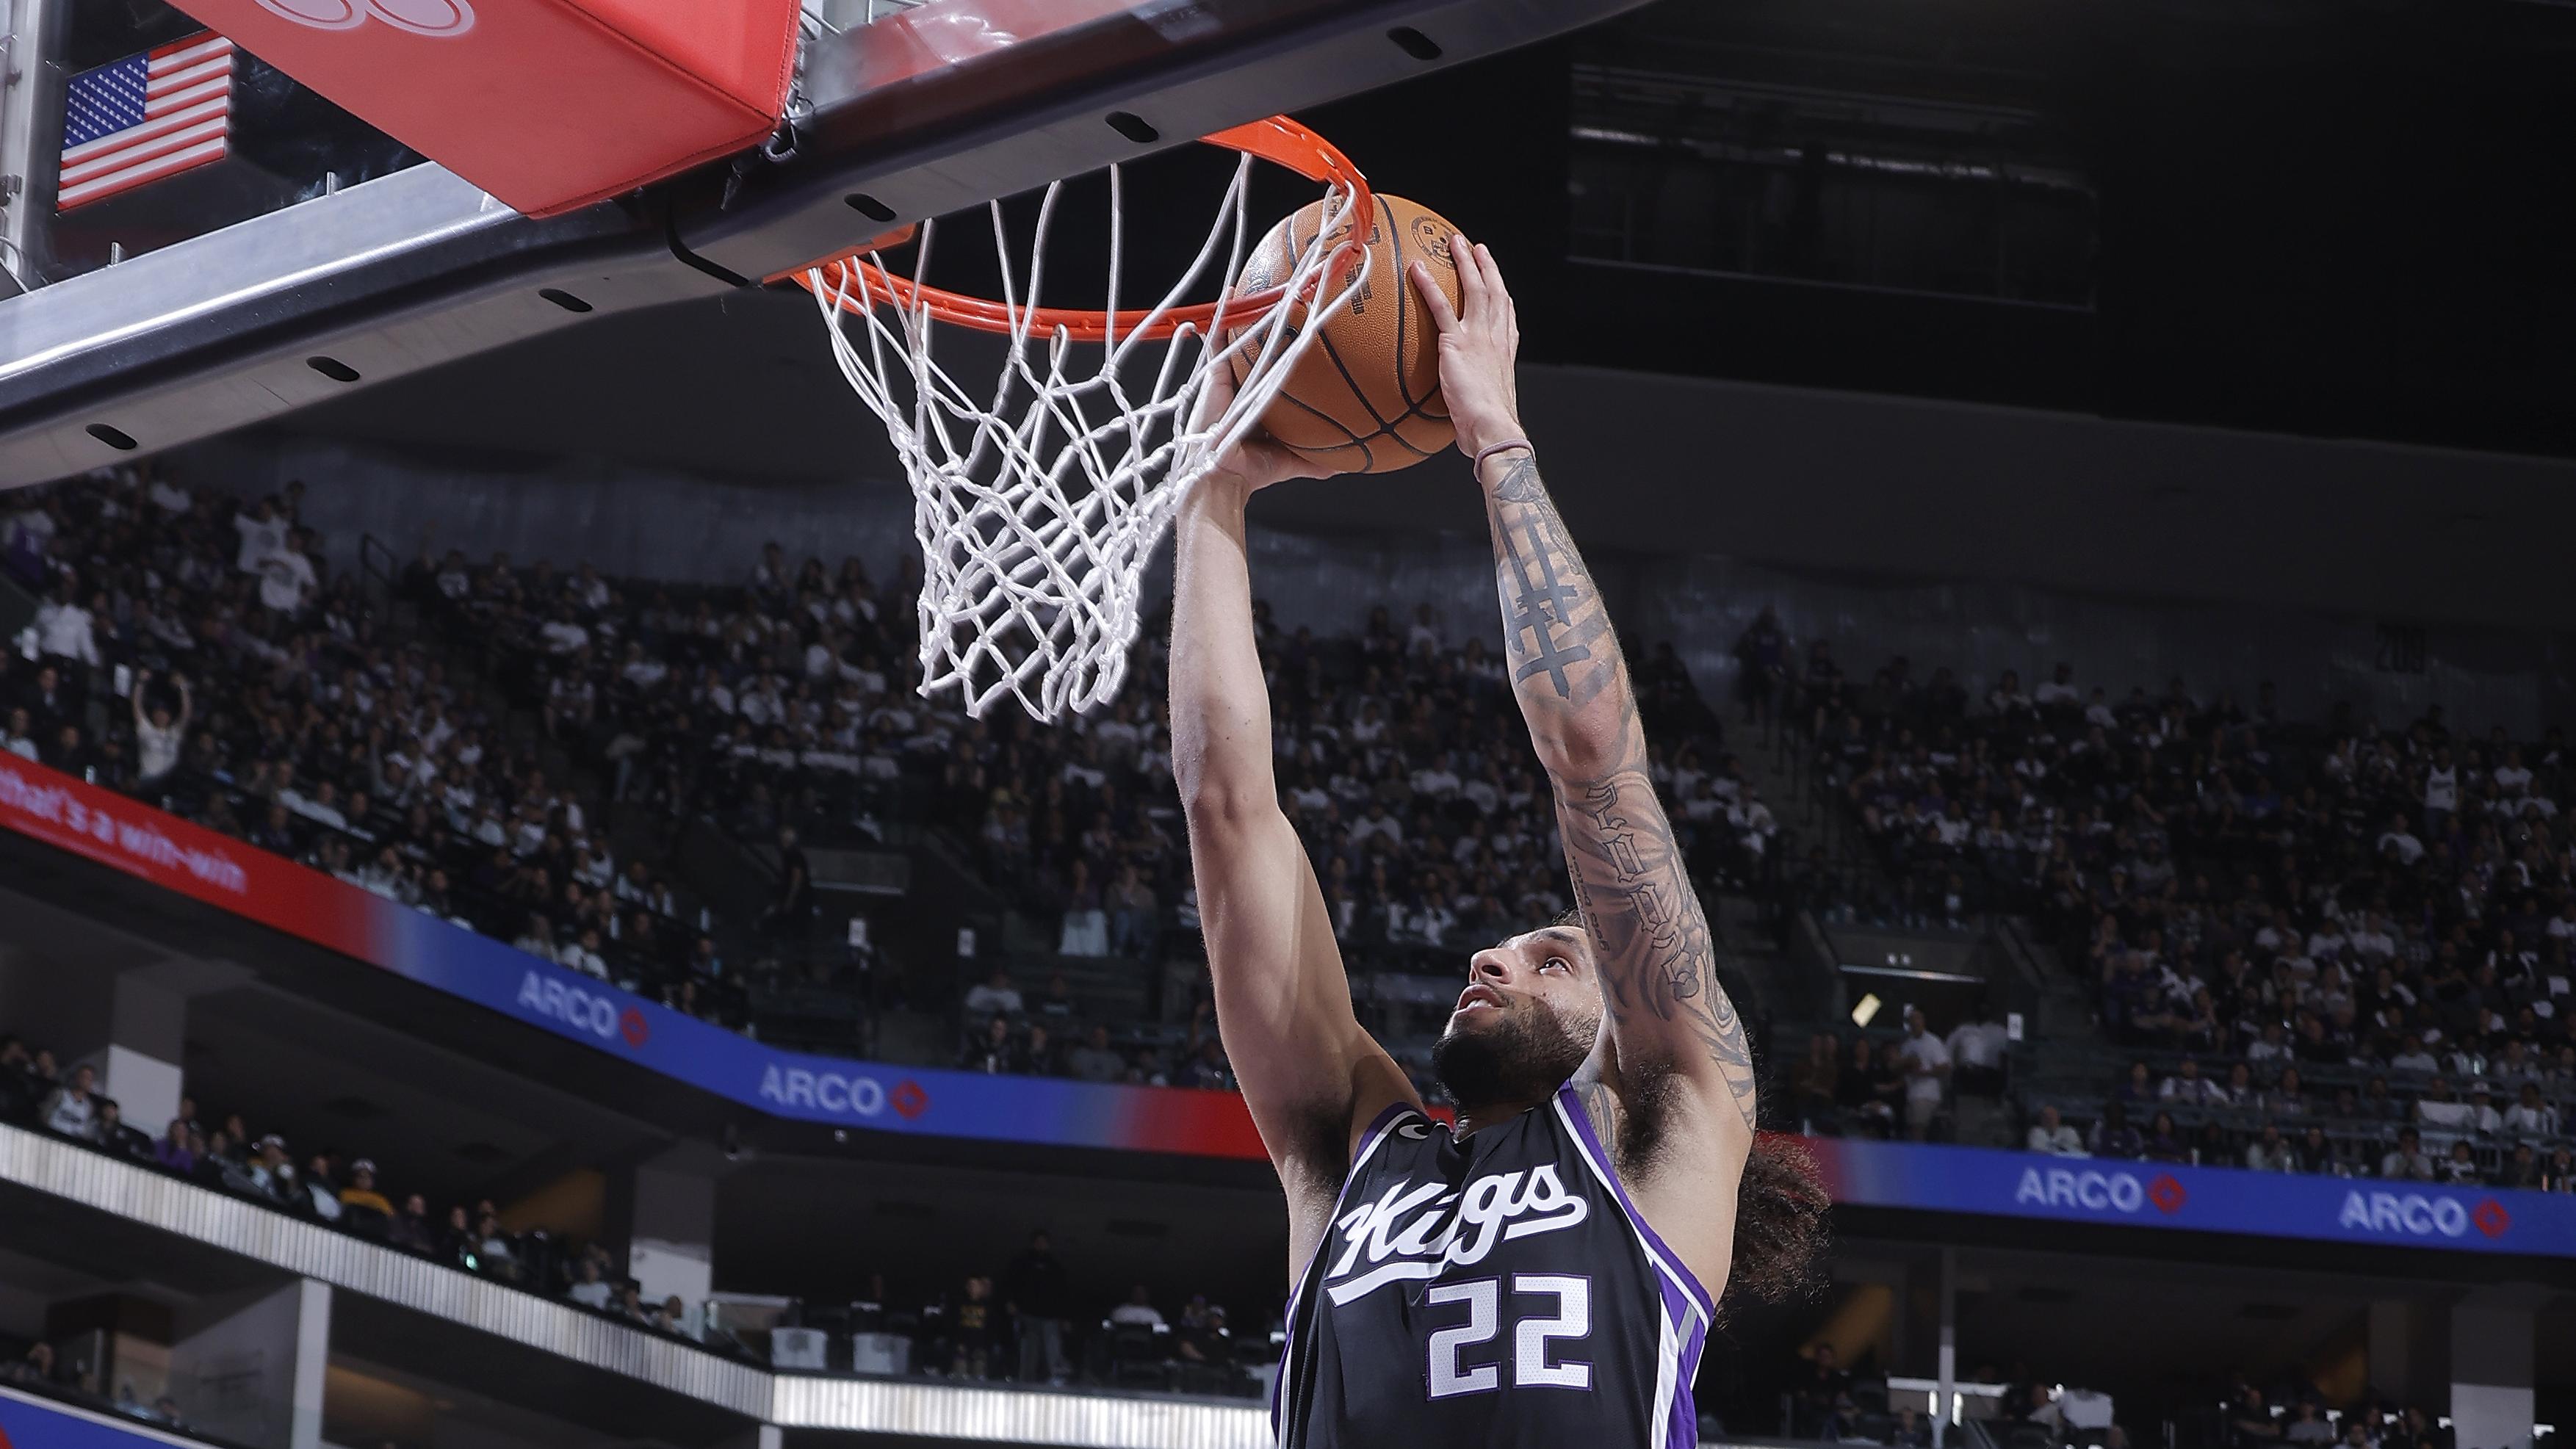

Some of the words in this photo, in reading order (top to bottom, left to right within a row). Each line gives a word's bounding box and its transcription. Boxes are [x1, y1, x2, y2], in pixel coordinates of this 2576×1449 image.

[90, 809, 115, 845] a
[117, 820, 248, 895] win-win
[517, 969, 618, 1039] ARCO
[758, 1063, 883, 1116] ARCO
[2016, 1167, 2143, 1214] ARCO
[2338, 1189, 2469, 1238] ARCO
[1324, 1162, 1590, 1308] Kigs
[1425, 1272, 1593, 1402] 22
